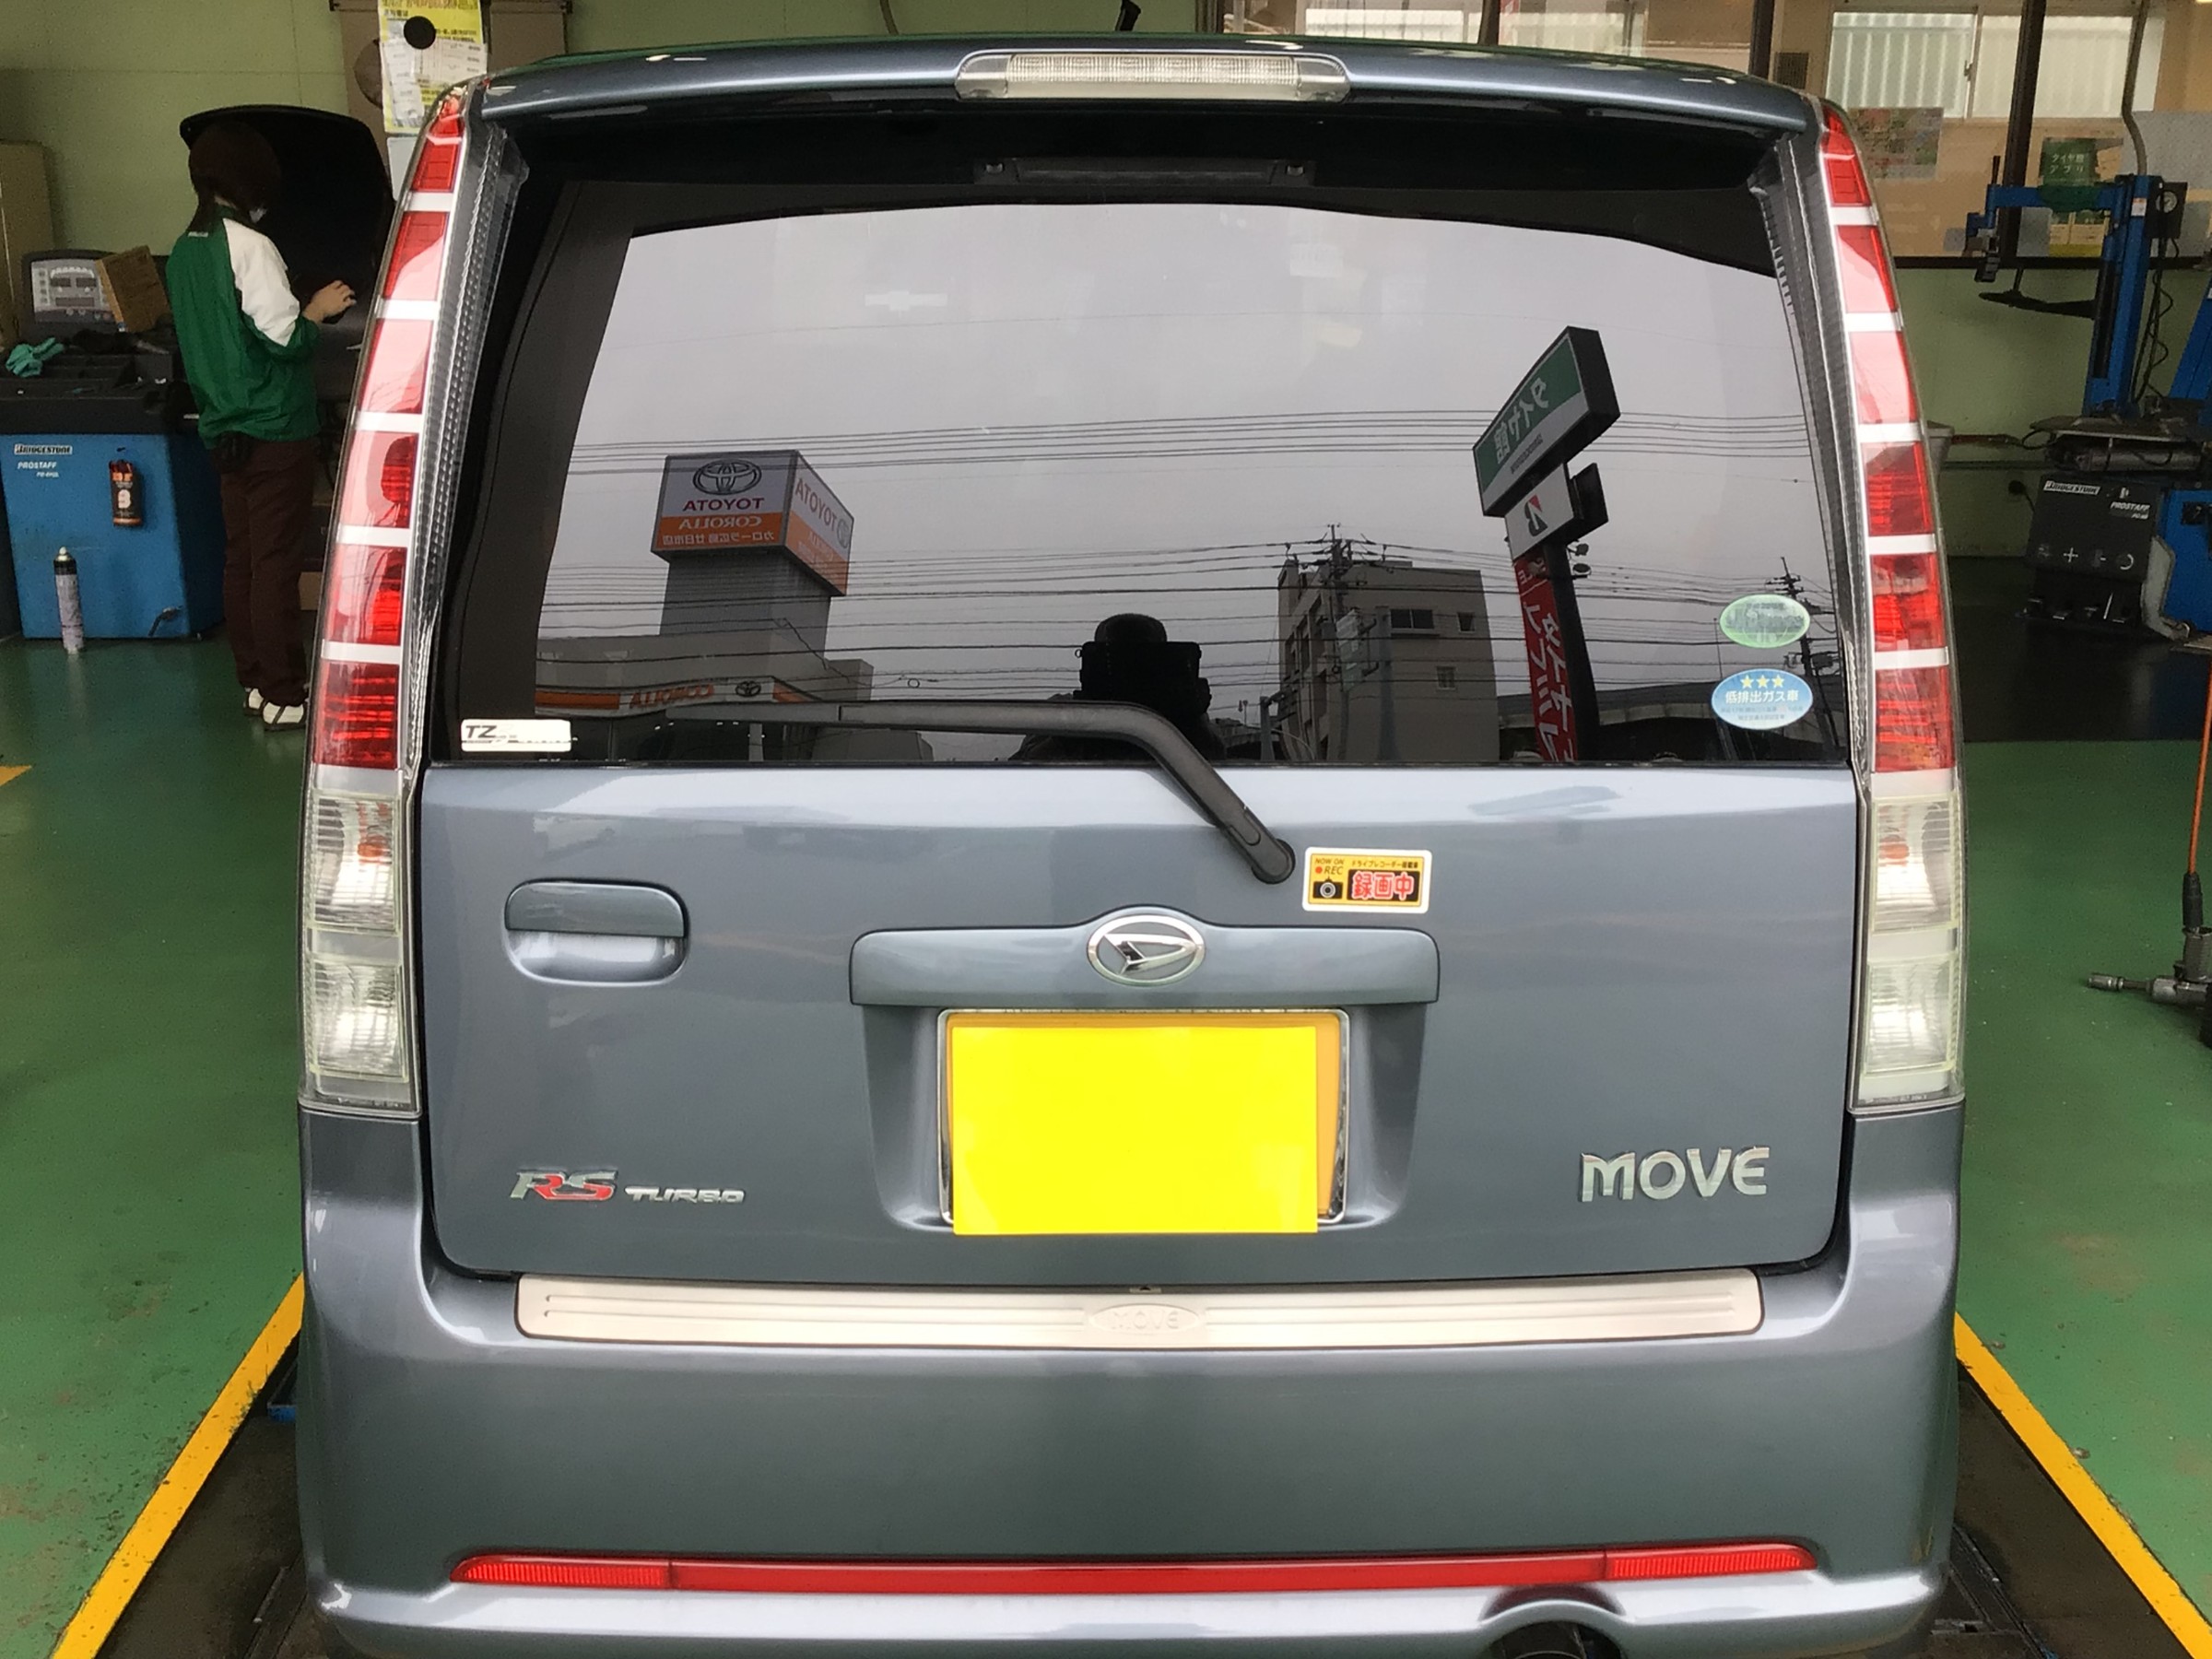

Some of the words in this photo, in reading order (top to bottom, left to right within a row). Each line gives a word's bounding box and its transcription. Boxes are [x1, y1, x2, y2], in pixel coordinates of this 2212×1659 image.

[1725, 689, 1799, 704] 低排出ガス車
[1324, 865, 1344, 875] REC
[1351, 871, 1415, 900] 録画中
[509, 1170, 618, 1202] RS
[624, 1185, 747, 1204] TURBO
[1580, 1146, 1771, 1203] MOVE
